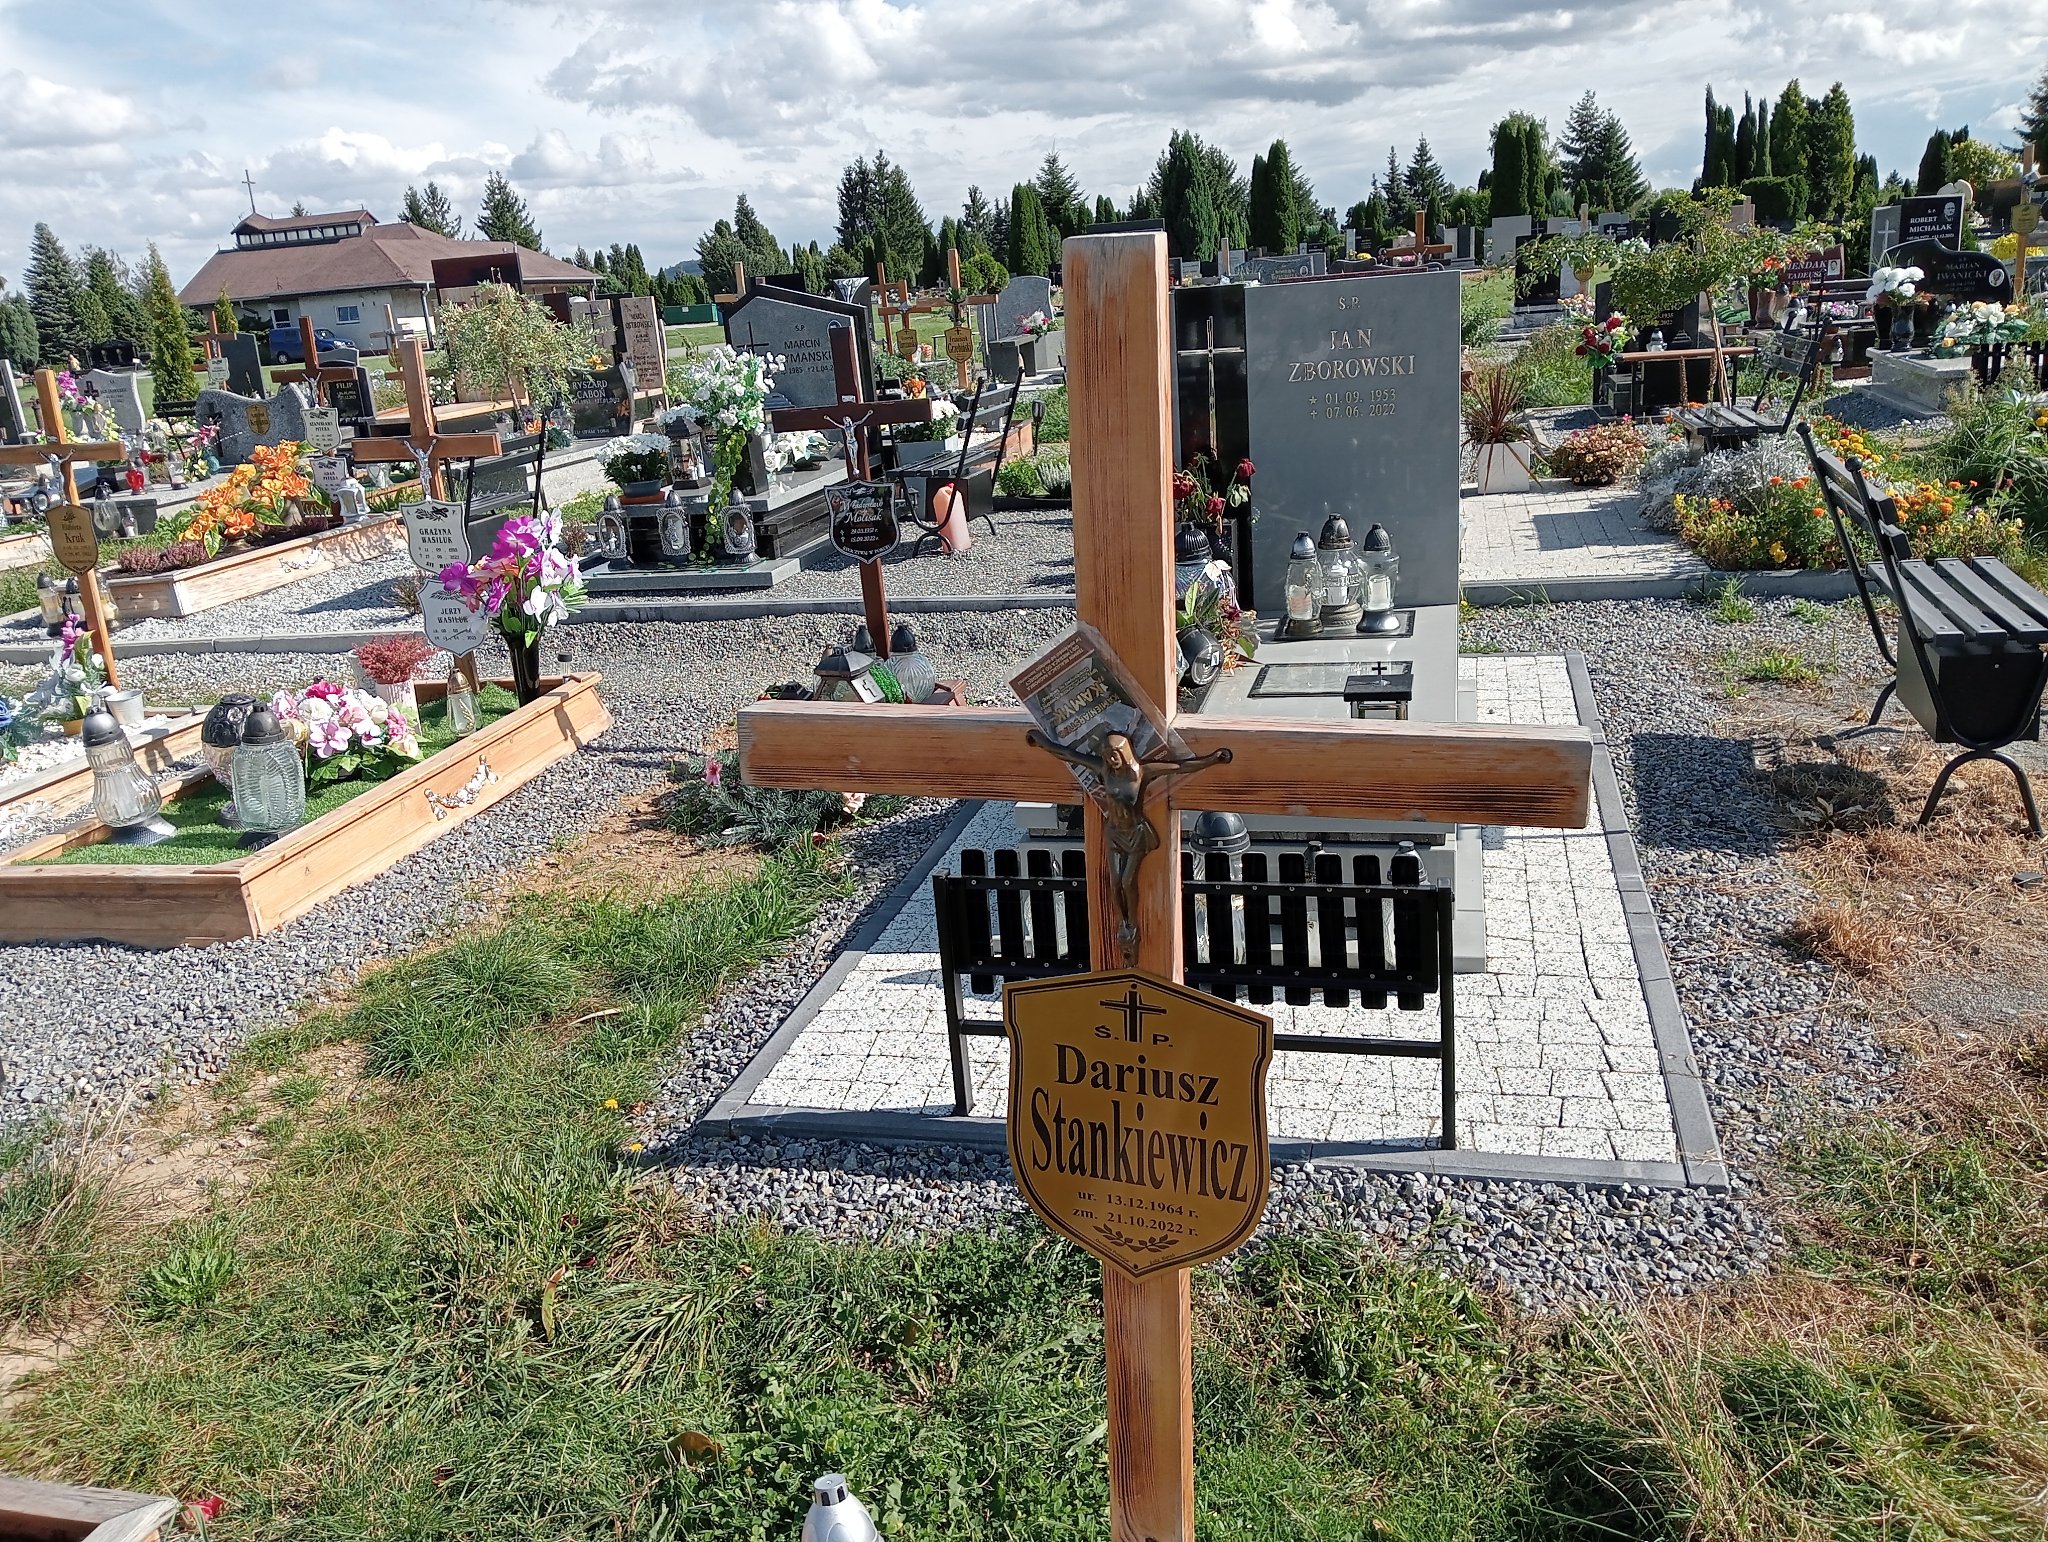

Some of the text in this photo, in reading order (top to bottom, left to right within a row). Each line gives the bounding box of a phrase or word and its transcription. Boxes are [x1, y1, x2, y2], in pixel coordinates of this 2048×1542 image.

[1910, 216, 1938, 224] ROBERT
[1909, 224, 1952, 233] MICHALAK
[1946, 262, 1980, 271] MARIAN
[1936, 270, 1987, 280] IWANICKI
[784, 339, 820, 349] MARCIN
[1330, 328, 1372, 350] JAN
[1288, 354, 1416, 382] ZBOROWSKI
[572, 380, 608, 390] RYSZARD
[1152, 1033, 1173, 1047] P.
[1054, 1043, 1220, 1106] Dariusz
[1031, 1087, 1248, 1203] Stankiewicz
[1077, 1192, 1199, 1218] ur. 13.12.1964 r.
[1072, 1208, 1198, 1237] zm. 21.10.2022 r.
